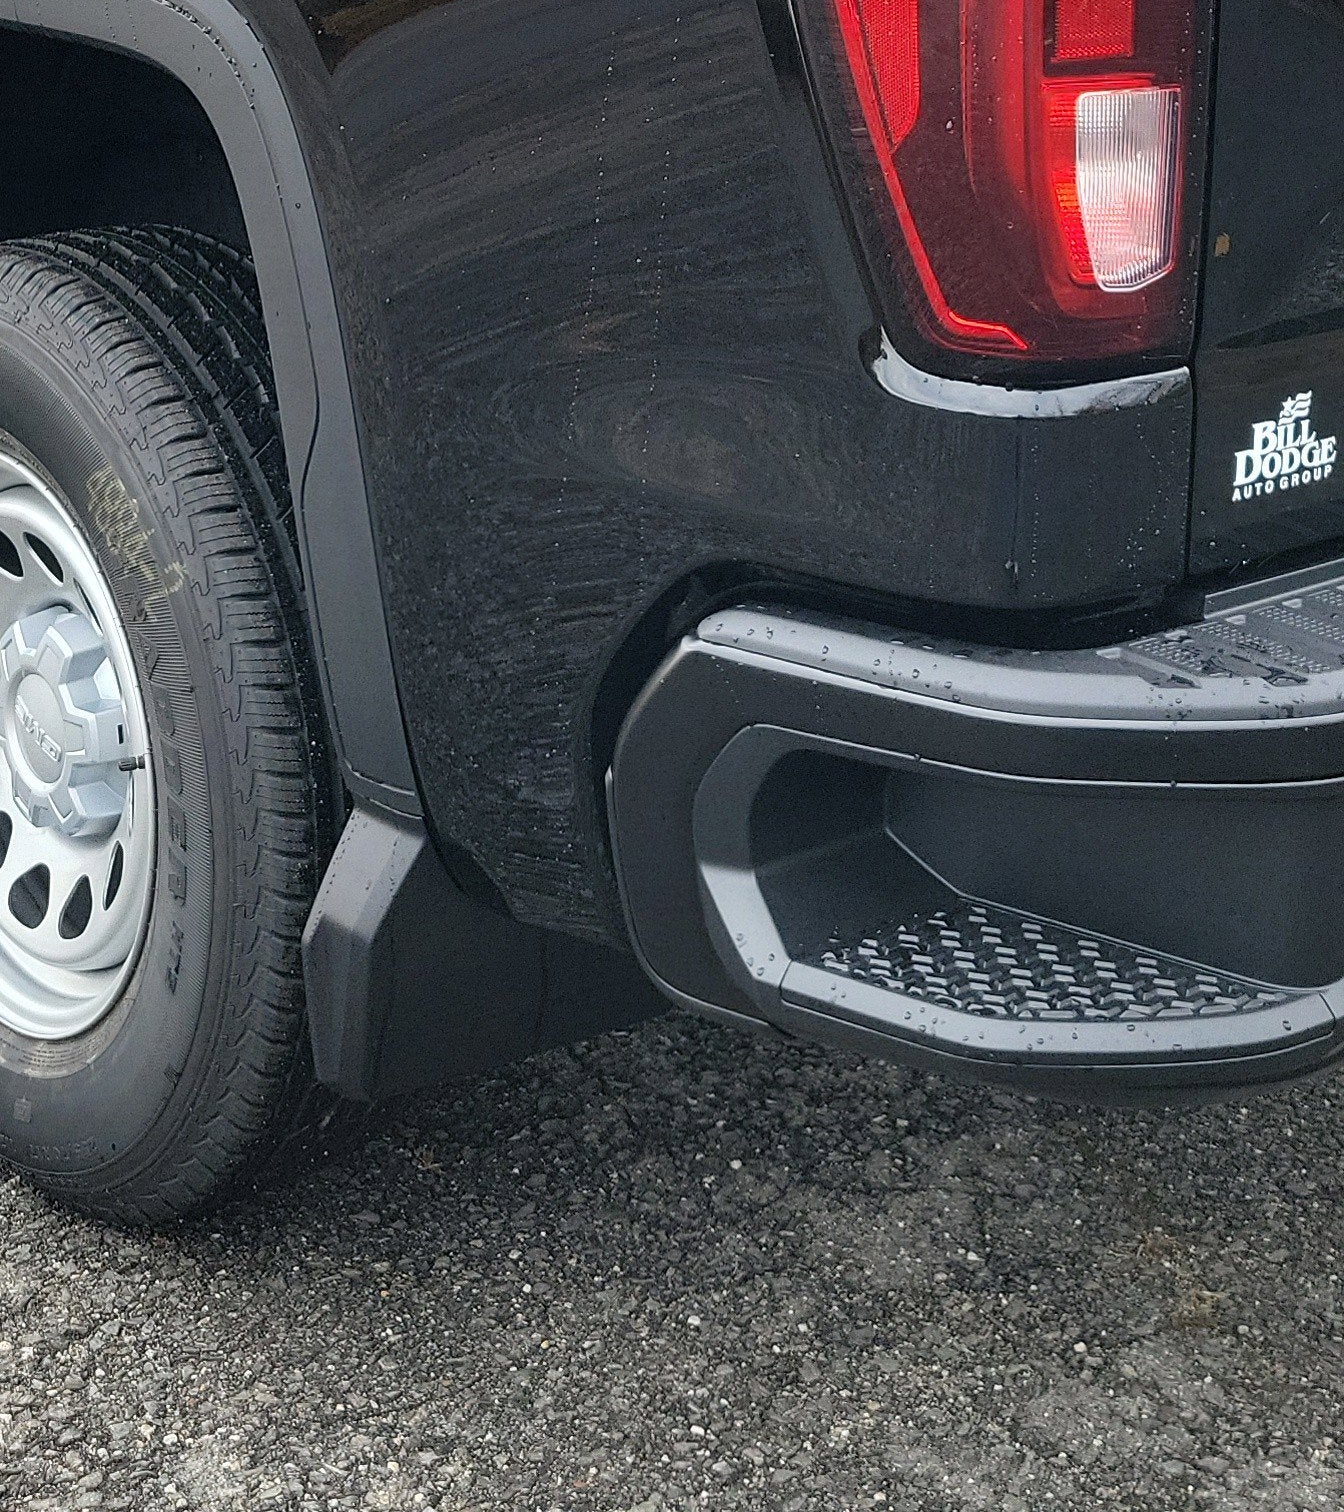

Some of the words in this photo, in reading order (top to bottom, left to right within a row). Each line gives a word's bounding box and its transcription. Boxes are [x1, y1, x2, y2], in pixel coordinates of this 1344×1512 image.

[1251, 418, 1318, 456] BILL
[1231, 479, 1274, 502] AUTO
[1279, 464, 1333, 490] GROUP
[1233, 435, 1338, 487] DODGE
[14, 694, 63, 763] GMC
